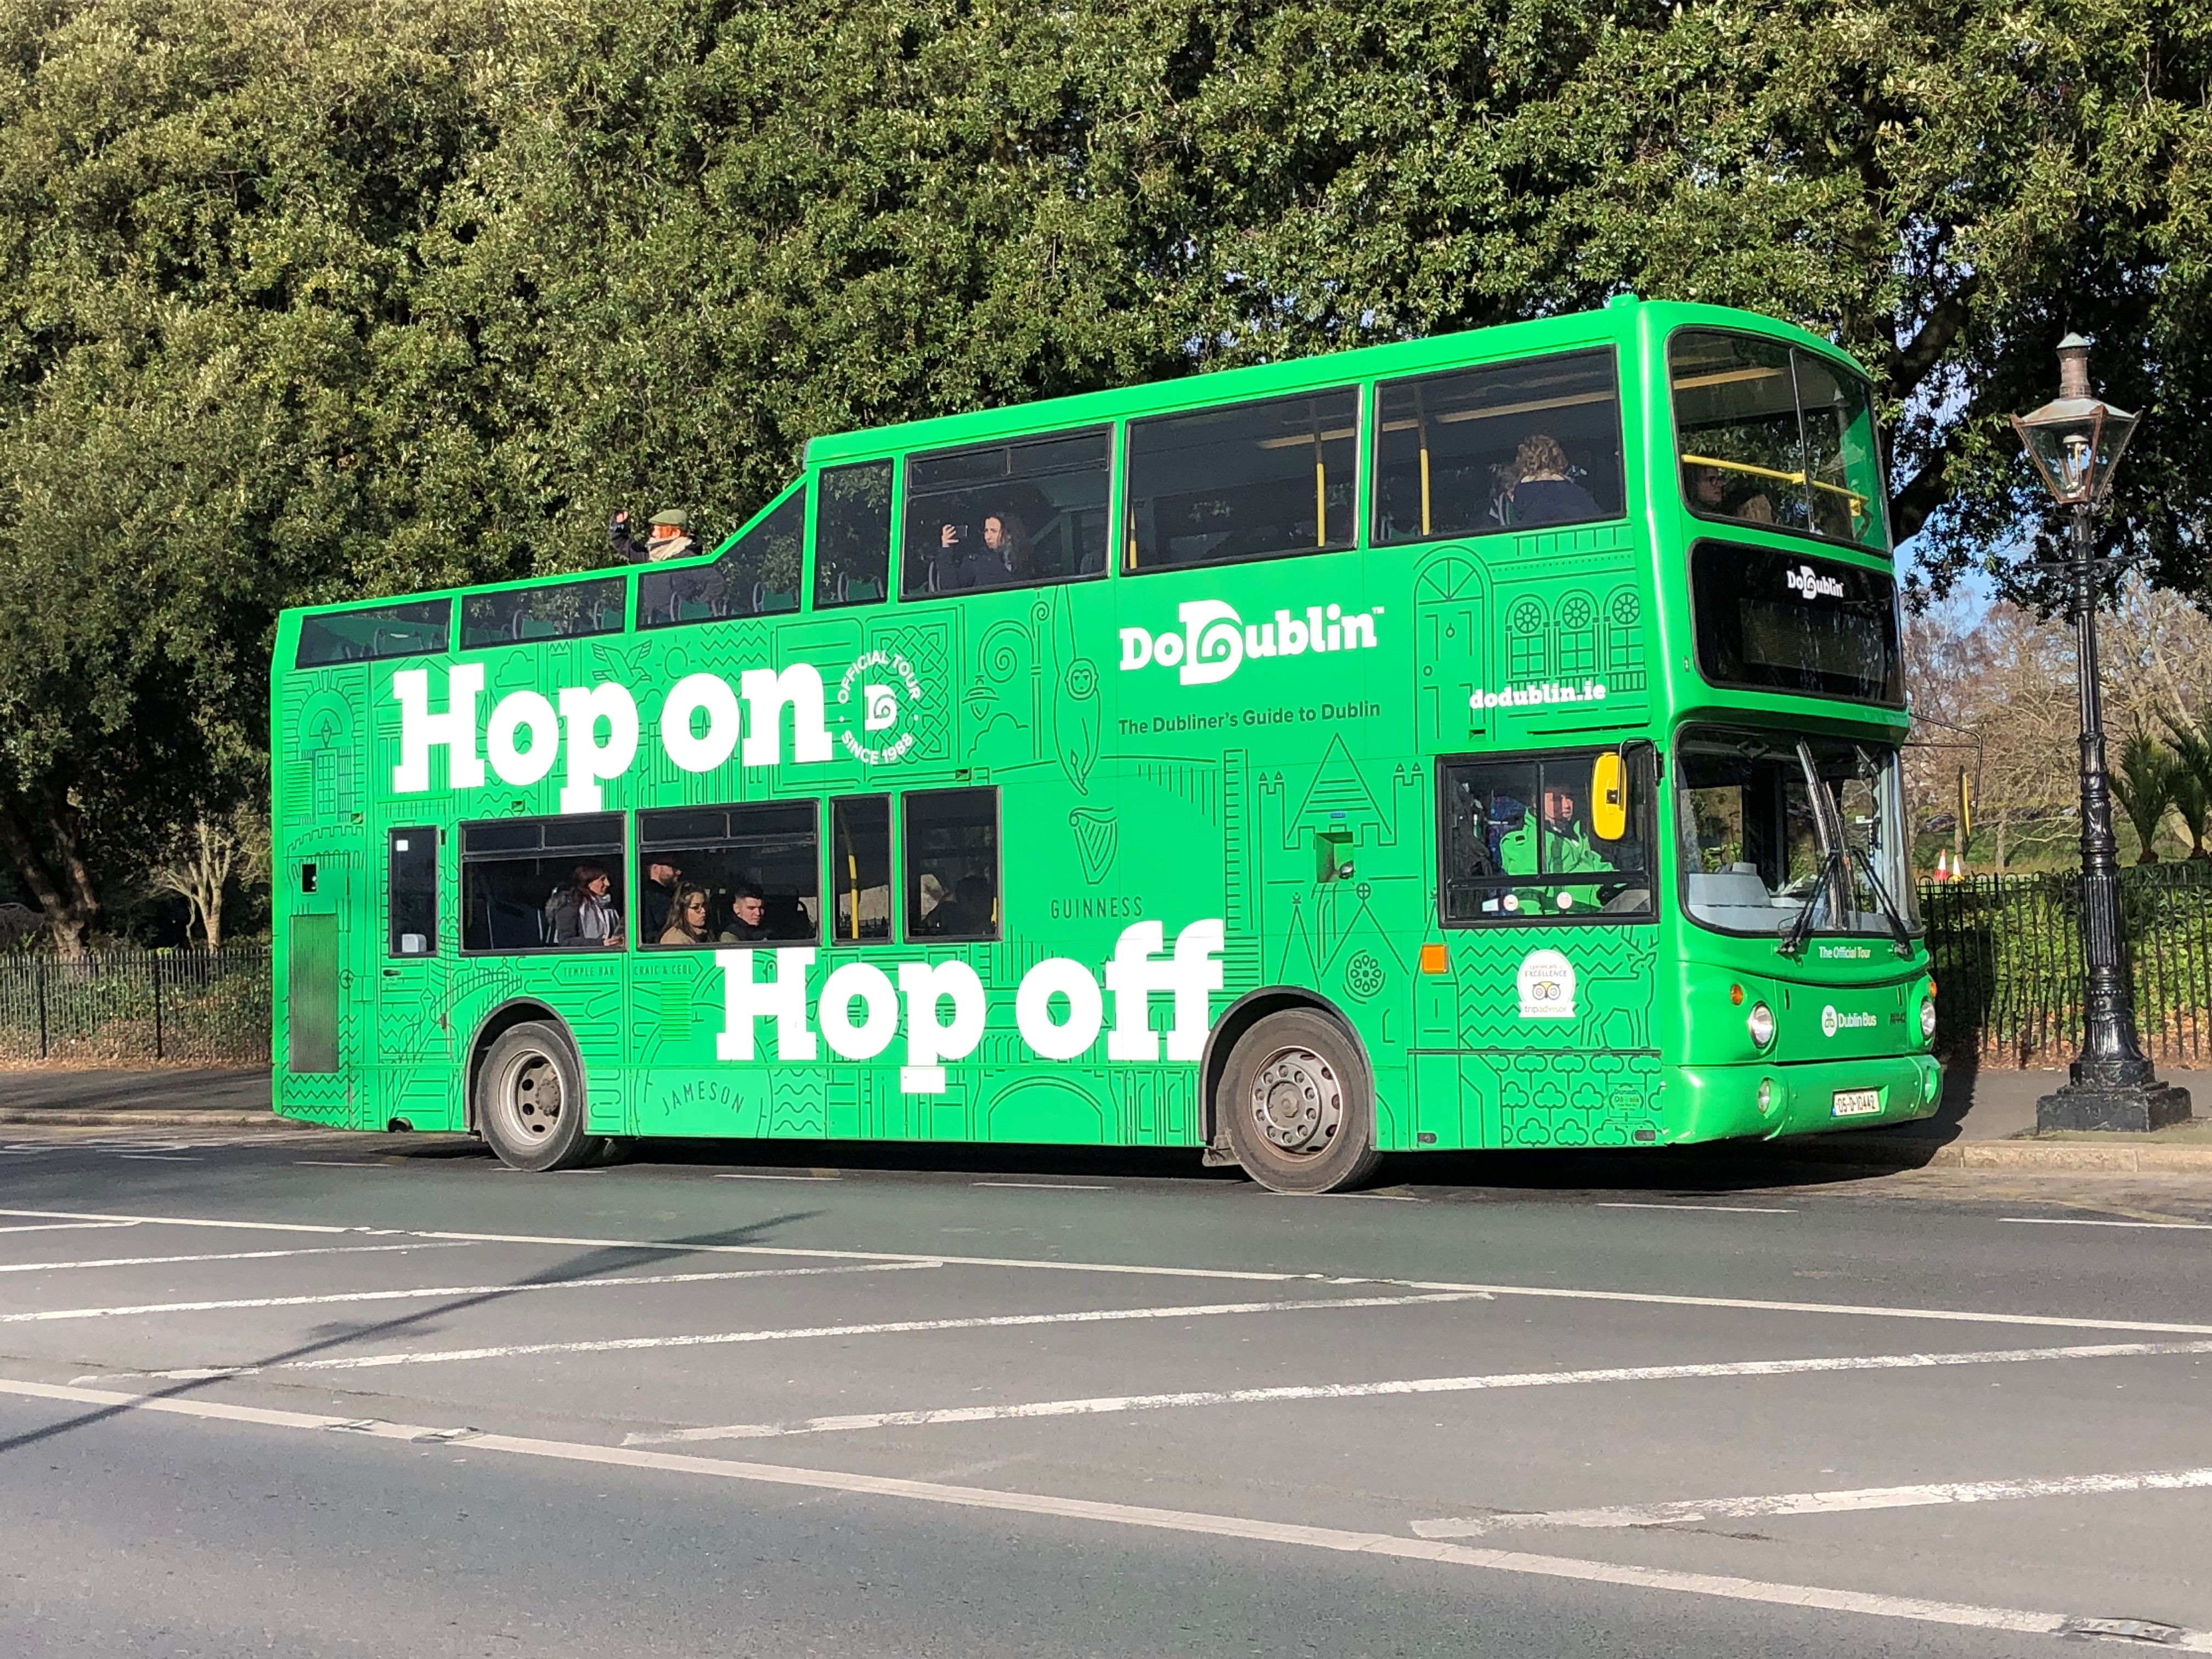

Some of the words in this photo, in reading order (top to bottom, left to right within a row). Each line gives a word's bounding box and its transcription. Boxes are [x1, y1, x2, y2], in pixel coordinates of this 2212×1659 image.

[837, 650, 889, 704] OFFICIAL
[893, 653, 921, 700] TOUR
[1469, 680, 1606, 709] dodublin.ie
[1118, 719, 1148, 735] The
[1153, 712, 1239, 733] Dubliner’s
[1243, 707, 1294, 726] Guide
[1299, 707, 1317, 722] to
[1322, 700, 1380, 720] Dublin
[392, 662, 640, 814] Hop
[660, 663, 833, 773] on
[841, 730, 879, 765] SINCE
[882, 732, 913, 764] 1988
[1051, 896, 1143, 919] GUINNESS
[1819, 946, 1832, 958] The
[1858, 946, 1871, 958] Tour
[563, 967, 594, 977] TEMPLE
[599, 966, 614, 977] BAR
[634, 965, 658, 975] CRAIC
[662, 965, 668, 975] &
[672, 964, 693, 975] CEOL
[713, 947, 987, 1094] Hop
[1015, 918, 1226, 1068] off
[1524, 1005, 1567, 1014] tripadvisor
[1838, 1012, 1862, 1028] Dublin
[1862, 1012, 1877, 1027] Bus
[662, 1080, 744, 1116] JAMESON
